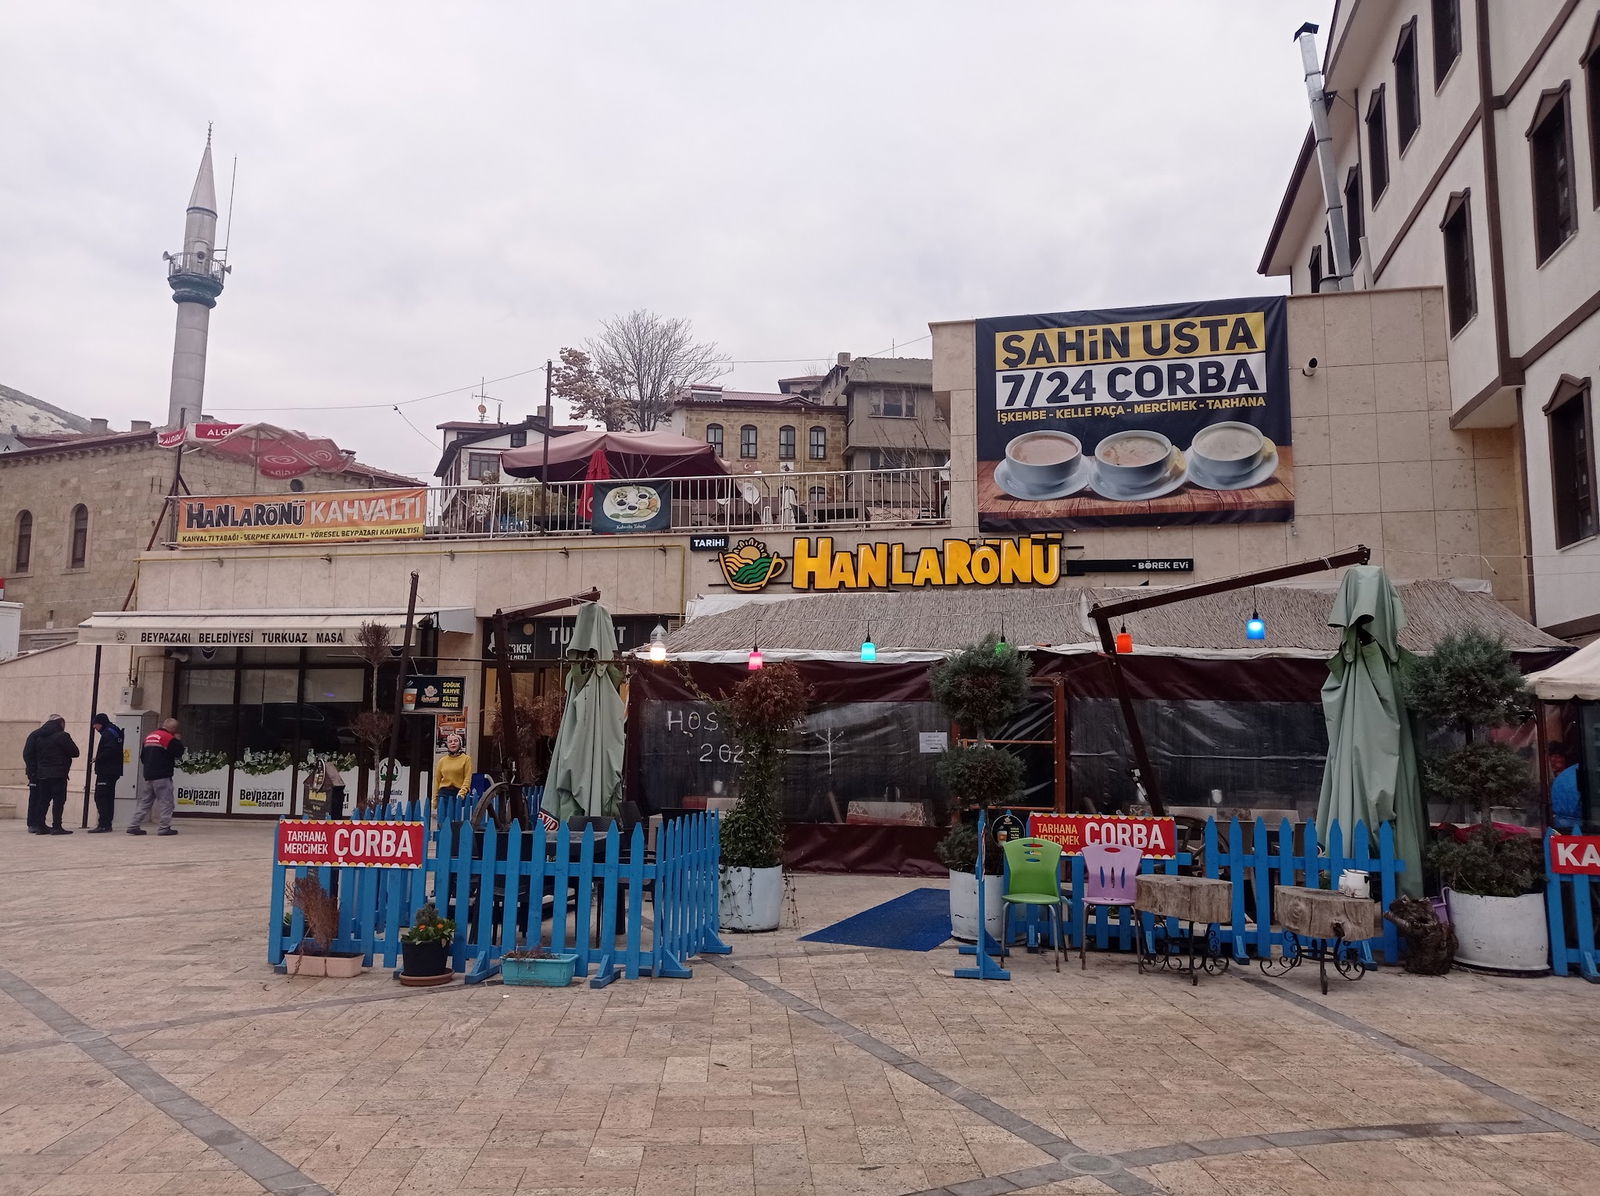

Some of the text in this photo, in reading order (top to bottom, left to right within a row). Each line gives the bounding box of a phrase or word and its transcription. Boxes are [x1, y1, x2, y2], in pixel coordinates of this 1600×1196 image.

[1142, 317, 1257, 357] USTA
[1001, 358, 1259, 407] 7/24 ÇORBA
[1055, 407, 1093, 420] KELLE
[1094, 406, 1125, 420] PAÇA
[1134, 399, 1198, 415] MERCİMEK
[1207, 396, 1266, 411] TARHANA
[310, 496, 421, 525] KAHVALTI
[243, 533, 271, 541] SERPME
[271, 532, 305, 540] KAHVALTI
[310, 530, 340, 538] YÖRESEL
[341, 529, 379, 537] BEYPAZARI
[1138, 560, 1171, 570] BÖREK
[140, 630, 344, 643] BEYPAZARI BELEDİYESİ TURKUAZ MASA
[508, 643, 532, 654] RKEK
[177, 787, 221, 801] Beypazarı
[239, 789, 285, 803] Beypazarı
[1037, 823, 1078, 835] TARHANA
[287, 828, 414, 863] TARHANA ÇORBA
